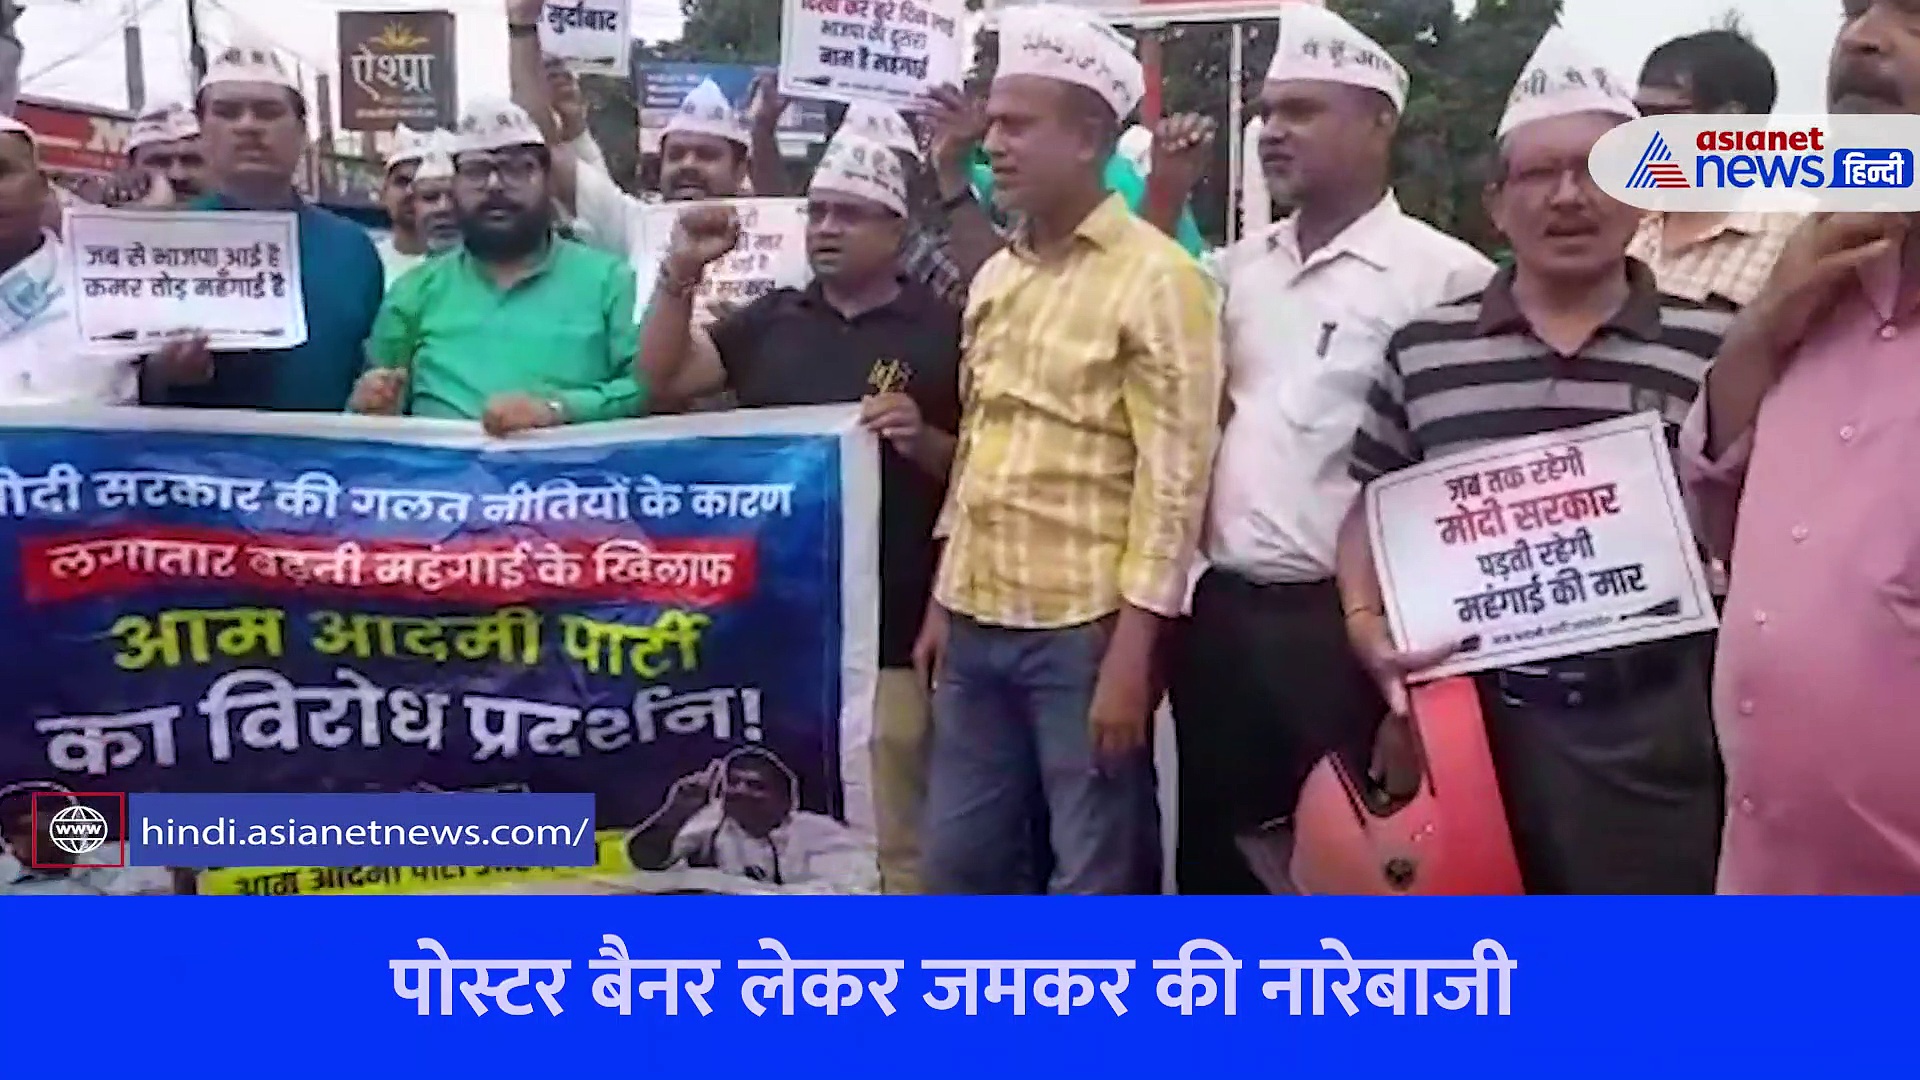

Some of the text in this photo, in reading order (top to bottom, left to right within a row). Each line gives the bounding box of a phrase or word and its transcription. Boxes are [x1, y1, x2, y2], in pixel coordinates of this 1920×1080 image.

[819, 46, 855, 67] नाम
[858, 46, 869, 70] है
[84, 242, 282, 268] जब से भाजपा आई है
[82, 277, 144, 298] कमर
[269, 271, 287, 298] है
[90, 469, 267, 513] सरकार
[272, 470, 342, 519] की
[347, 486, 473, 522] गलत
[479, 477, 632, 523] नीतियों
[635, 473, 684, 519] के
[688, 481, 796, 519] कारण
[1445, 447, 1586, 502] जब तक रहेगी
[1435, 482, 1621, 545] मोदी सरकार
[45, 537, 239, 580] लगातार
[370, 541, 533, 591] महंगाई
[534, 541, 583, 587] के
[1536, 526, 1596, 567] रहेगी
[1453, 562, 1649, 625] महंगाई की मार
[110, 607, 712, 679] आम आदमी पार्टी
[33, 667, 764, 776] का विरोध प्रदर्शन!
